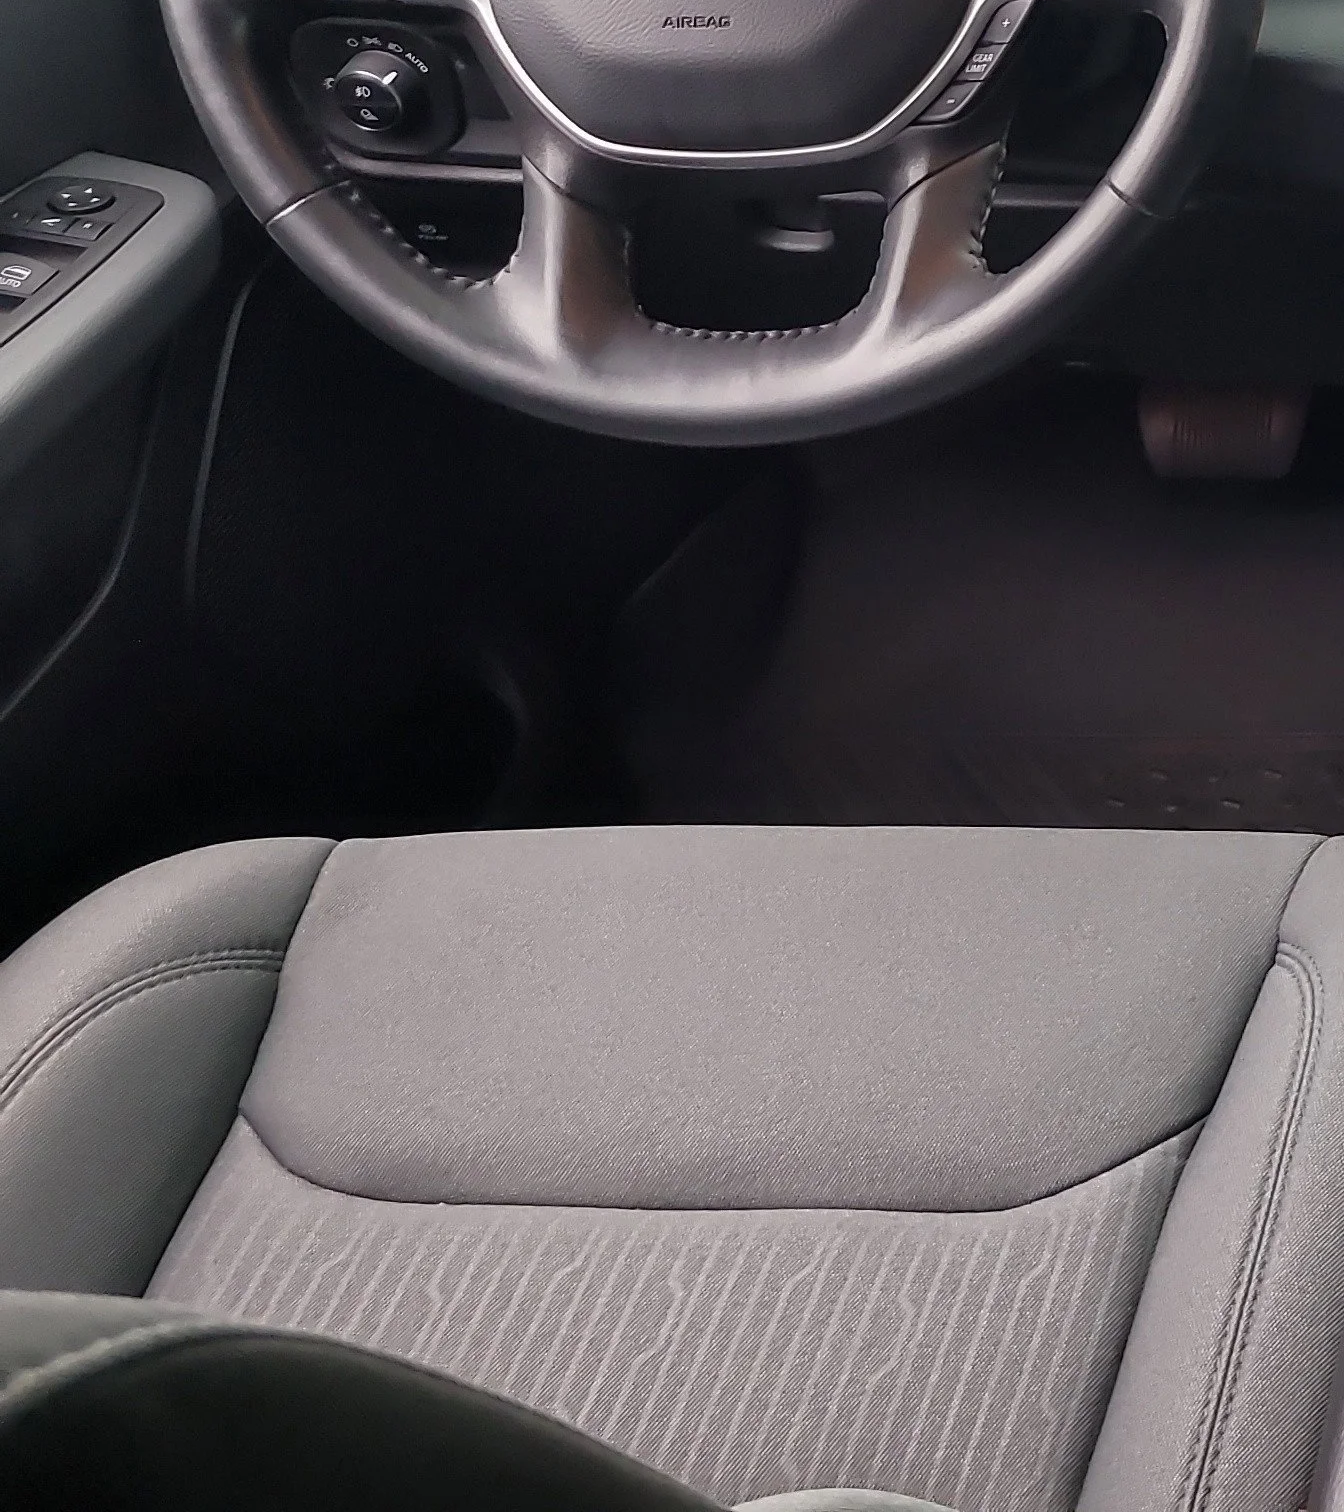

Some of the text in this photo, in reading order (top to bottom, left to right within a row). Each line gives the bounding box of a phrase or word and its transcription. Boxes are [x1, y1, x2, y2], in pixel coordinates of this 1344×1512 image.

[661, 16, 731, 29] AIRBAG
[404, 52, 429, 73] AUTO
[972, 53, 994, 63] GEAR
[966, 64, 988, 73] LIMIT
